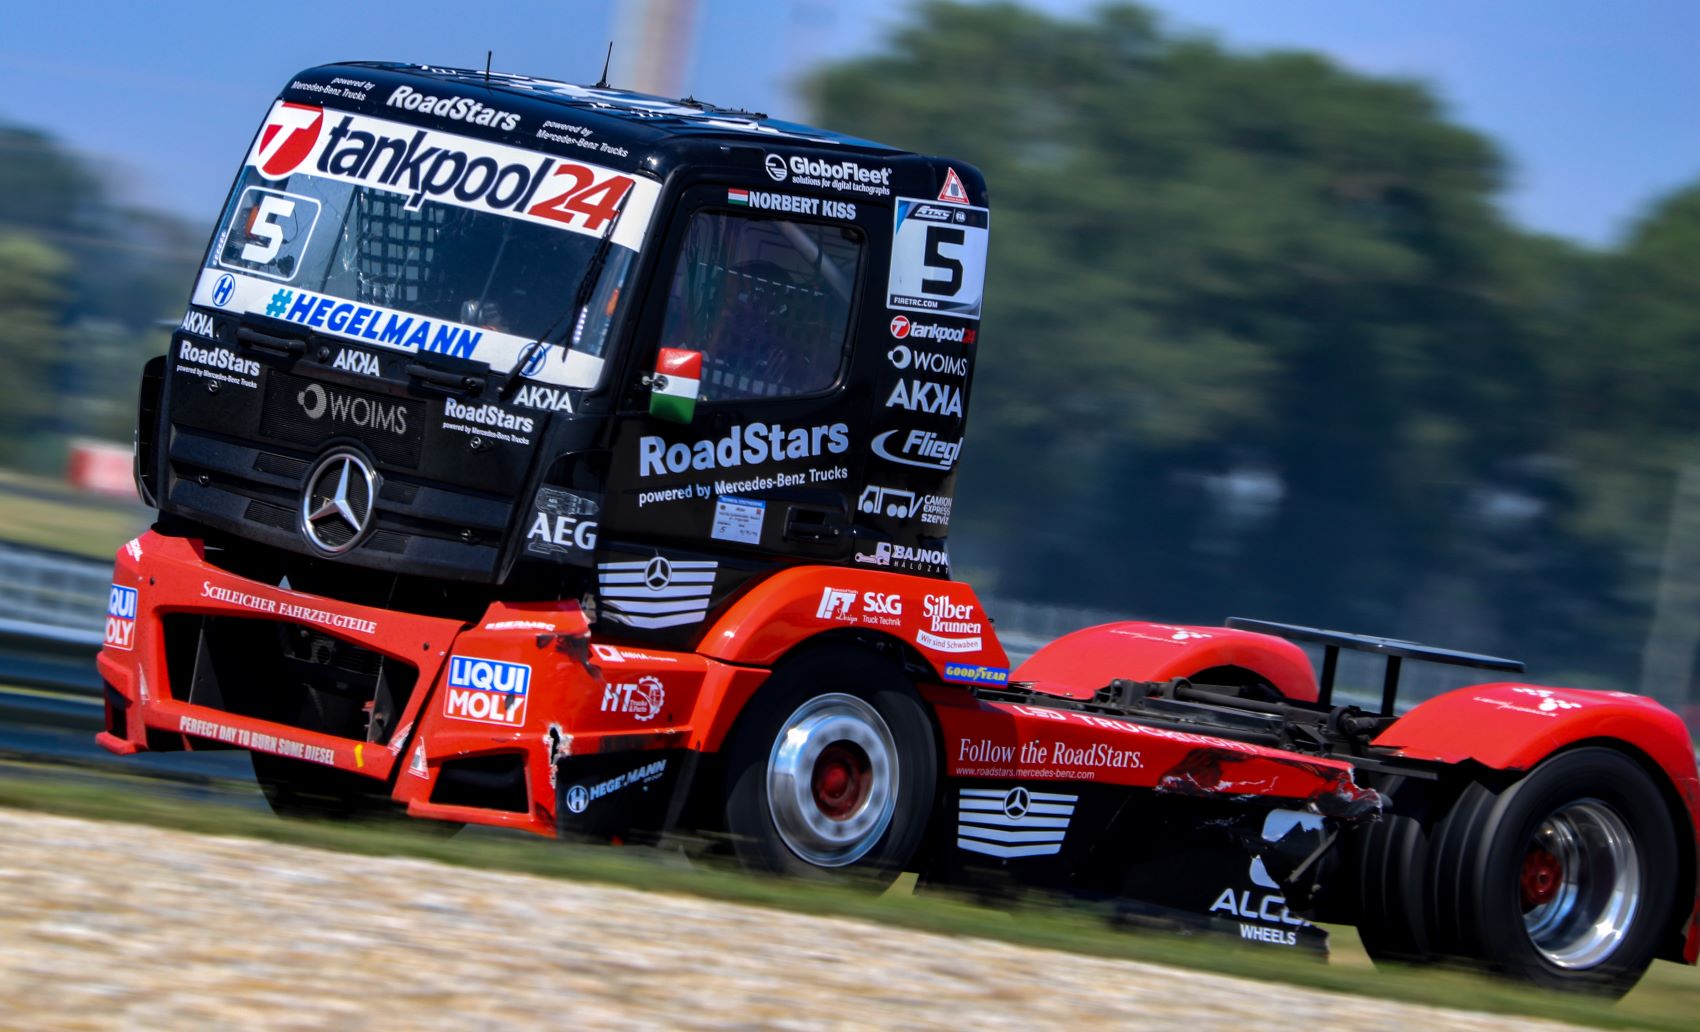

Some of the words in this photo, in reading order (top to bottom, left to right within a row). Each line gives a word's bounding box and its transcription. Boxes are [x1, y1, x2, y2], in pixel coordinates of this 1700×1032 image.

[291, 80, 342, 96] Mercedes-Benz
[342, 88, 367, 101] Trucks
[331, 77, 368, 88] powered
[386, 85, 521, 131] RoadStars
[535, 129, 599, 150] Mercedes-Benz
[599, 142, 629, 158] Trucks
[542, 120, 582, 133] powered
[581, 127, 594, 137] by
[317, 115, 635, 232] tankpool24
[792, 175, 822, 187] solutions
[821, 178, 832, 188] for
[831, 180, 852, 192] digital
[852, 182, 890, 196] tachographs
[749, 191, 819, 216] NORBERT
[822, 199, 857, 221] KISS
[241, 196, 297, 265] 5
[921, 225, 965, 297] 5
[266, 288, 484, 360] #HEGELMANN
[179, 340, 260, 377] RoadStars
[913, 350, 967, 376] WOIMS
[330, 391, 408, 435] WOIMS
[444, 397, 534, 433] RoadStars
[639, 422, 849, 477] RoadStars
[902, 429, 964, 466] Fliegl
[639, 485, 693, 507] powered
[696, 484, 711, 499] by
[715, 472, 806, 495] Mercedes-Benz
[809, 466, 848, 482] Trucks
[924, 494, 952, 507] CAMION
[923, 504, 951, 516] EXPRESS
[527, 511, 598, 550] AEG
[201, 581, 276, 613] SCHLEICHER
[278, 602, 377, 634] FAHRZEUGTEILE
[863, 592, 902, 615] S&G
[923, 594, 974, 620] Silber
[863, 615, 878, 624] Truck
[879, 616, 901, 626] Technik
[931, 616, 982, 634] Brunnen
[920, 632, 933, 646] Wir
[933, 637, 946, 648] sind
[947, 639, 979, 649] Schwaben
[451, 659, 526, 693] LIQUI
[447, 689, 524, 722] MOLY
[179, 715, 218, 737] PERFECT
[218, 724, 238, 741] DAY
[237, 729, 250, 745] TO
[250, 732, 277, 754] BURN
[277, 739, 304, 758] SOME
[304, 744, 335, 766] DIESEL
[958, 738, 1016, 763] Follow
[1020, 739, 1047, 764] the
[1052, 741, 1145, 769] RoadStars.
[956, 766, 1095, 780] www.roadstars.mercedes-benz.com
[1240, 924, 1296, 945] WHEELS
